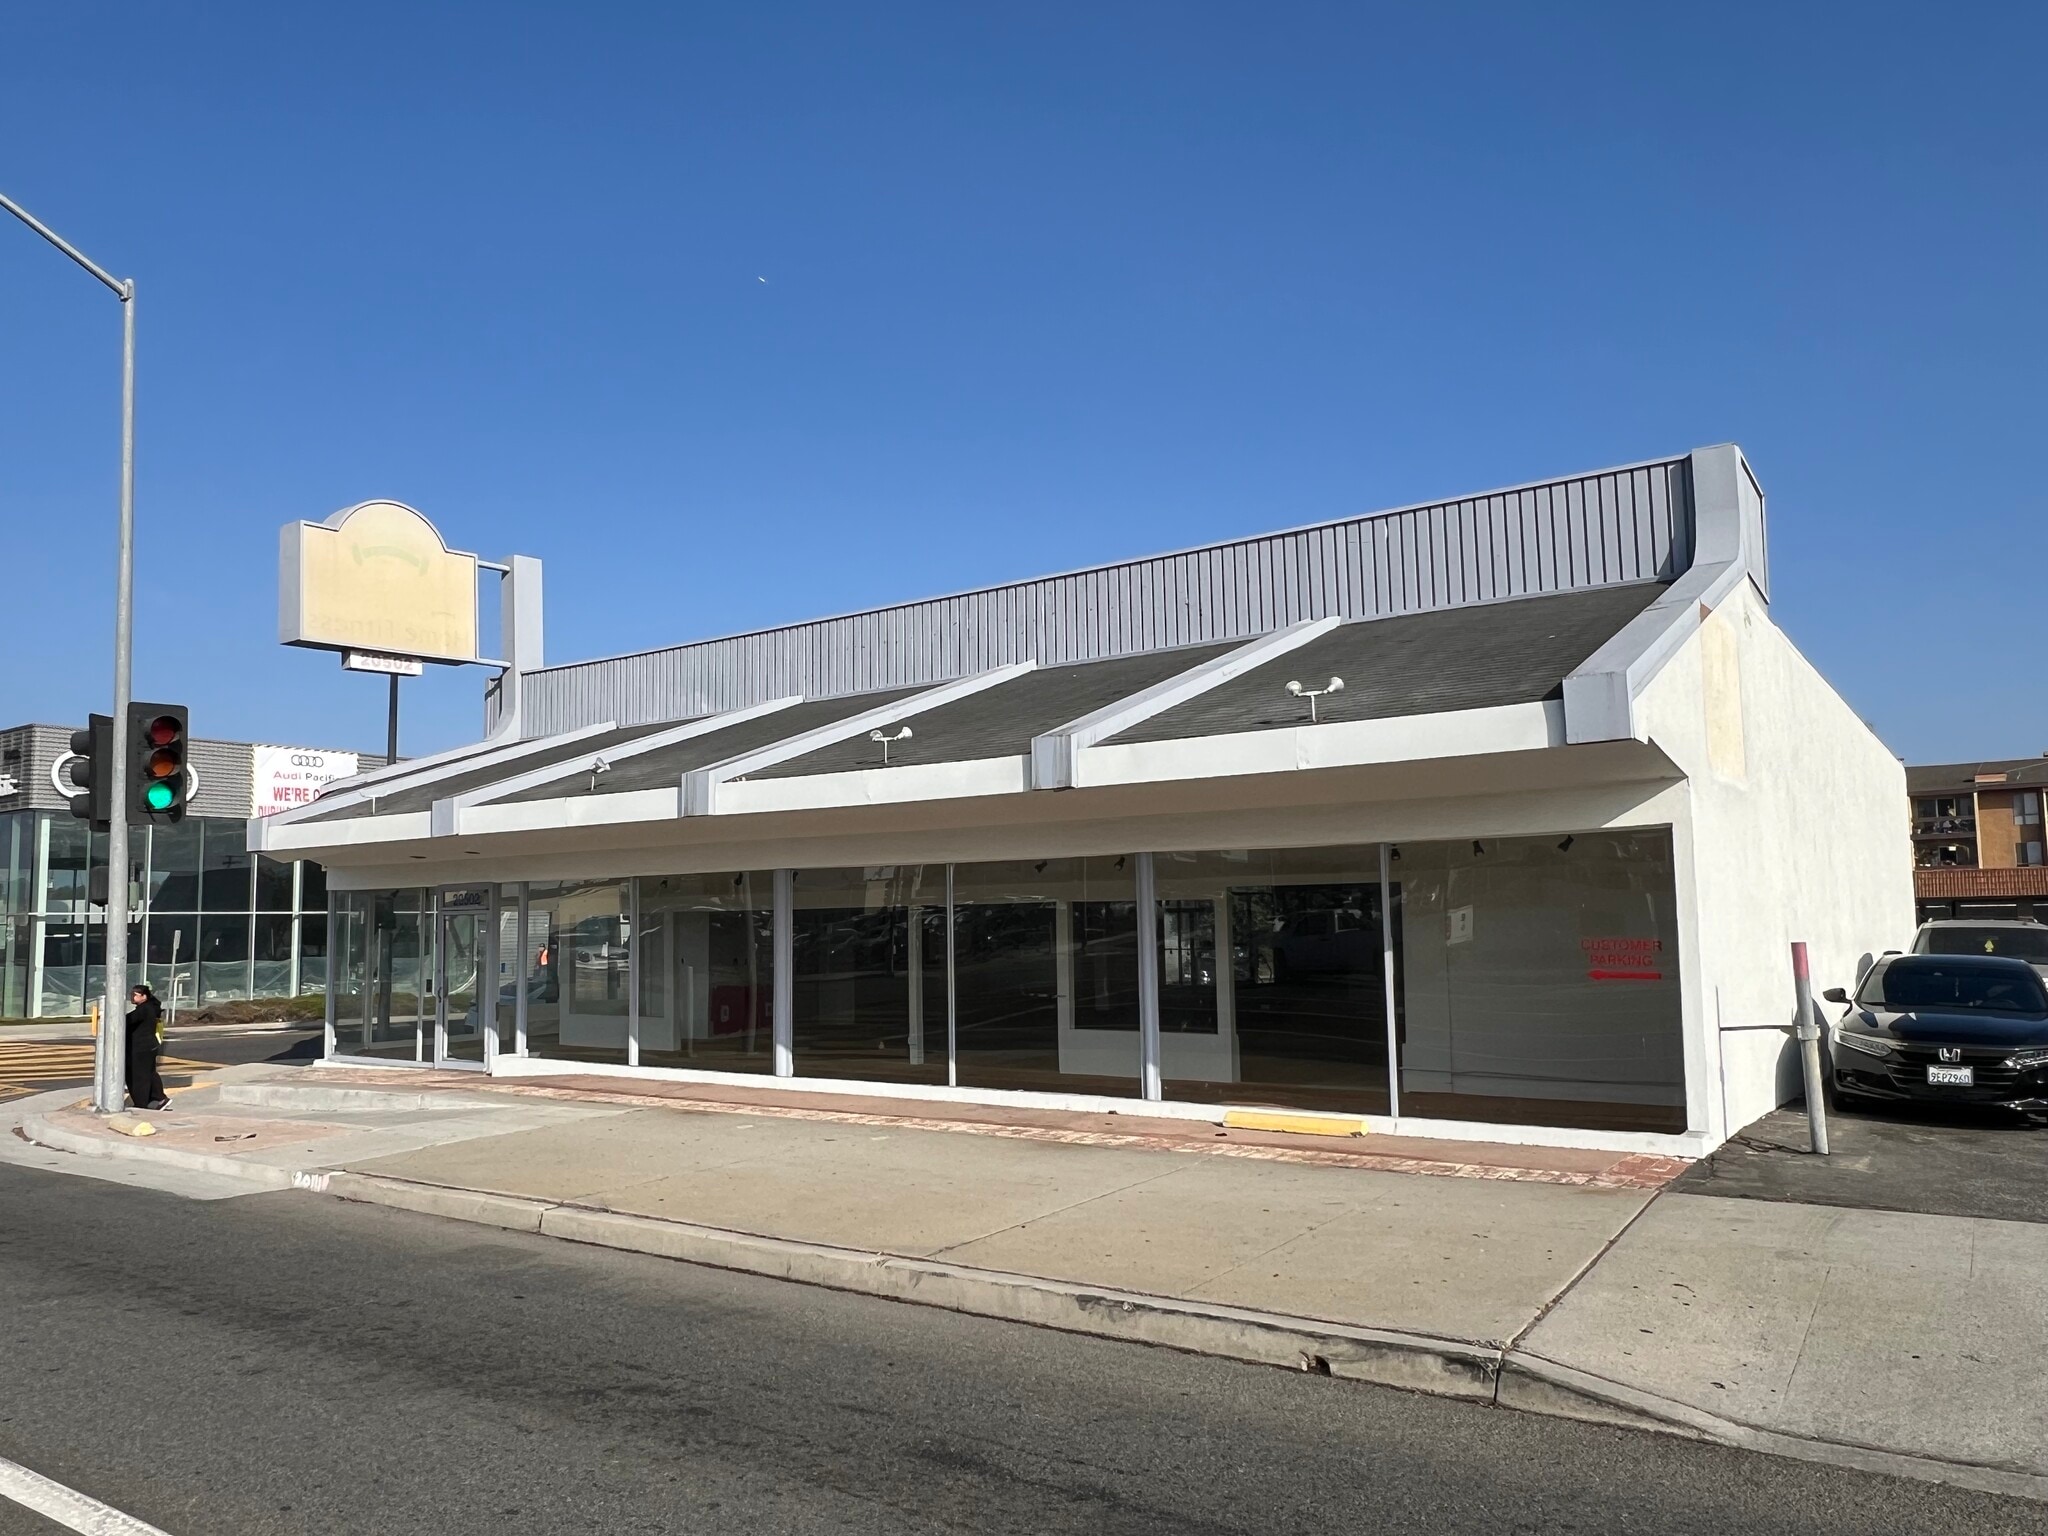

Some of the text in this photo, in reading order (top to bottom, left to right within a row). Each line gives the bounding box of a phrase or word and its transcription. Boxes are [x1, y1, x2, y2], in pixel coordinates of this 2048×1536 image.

[360, 653, 414, 671] 20502
[273, 771, 302, 780] Audi
[273, 787, 310, 802] WE'RE
[453, 892, 480, 906] 20502
[1581, 939, 1663, 952] CUSTOMER
[1590, 955, 1653, 967] PARKING
